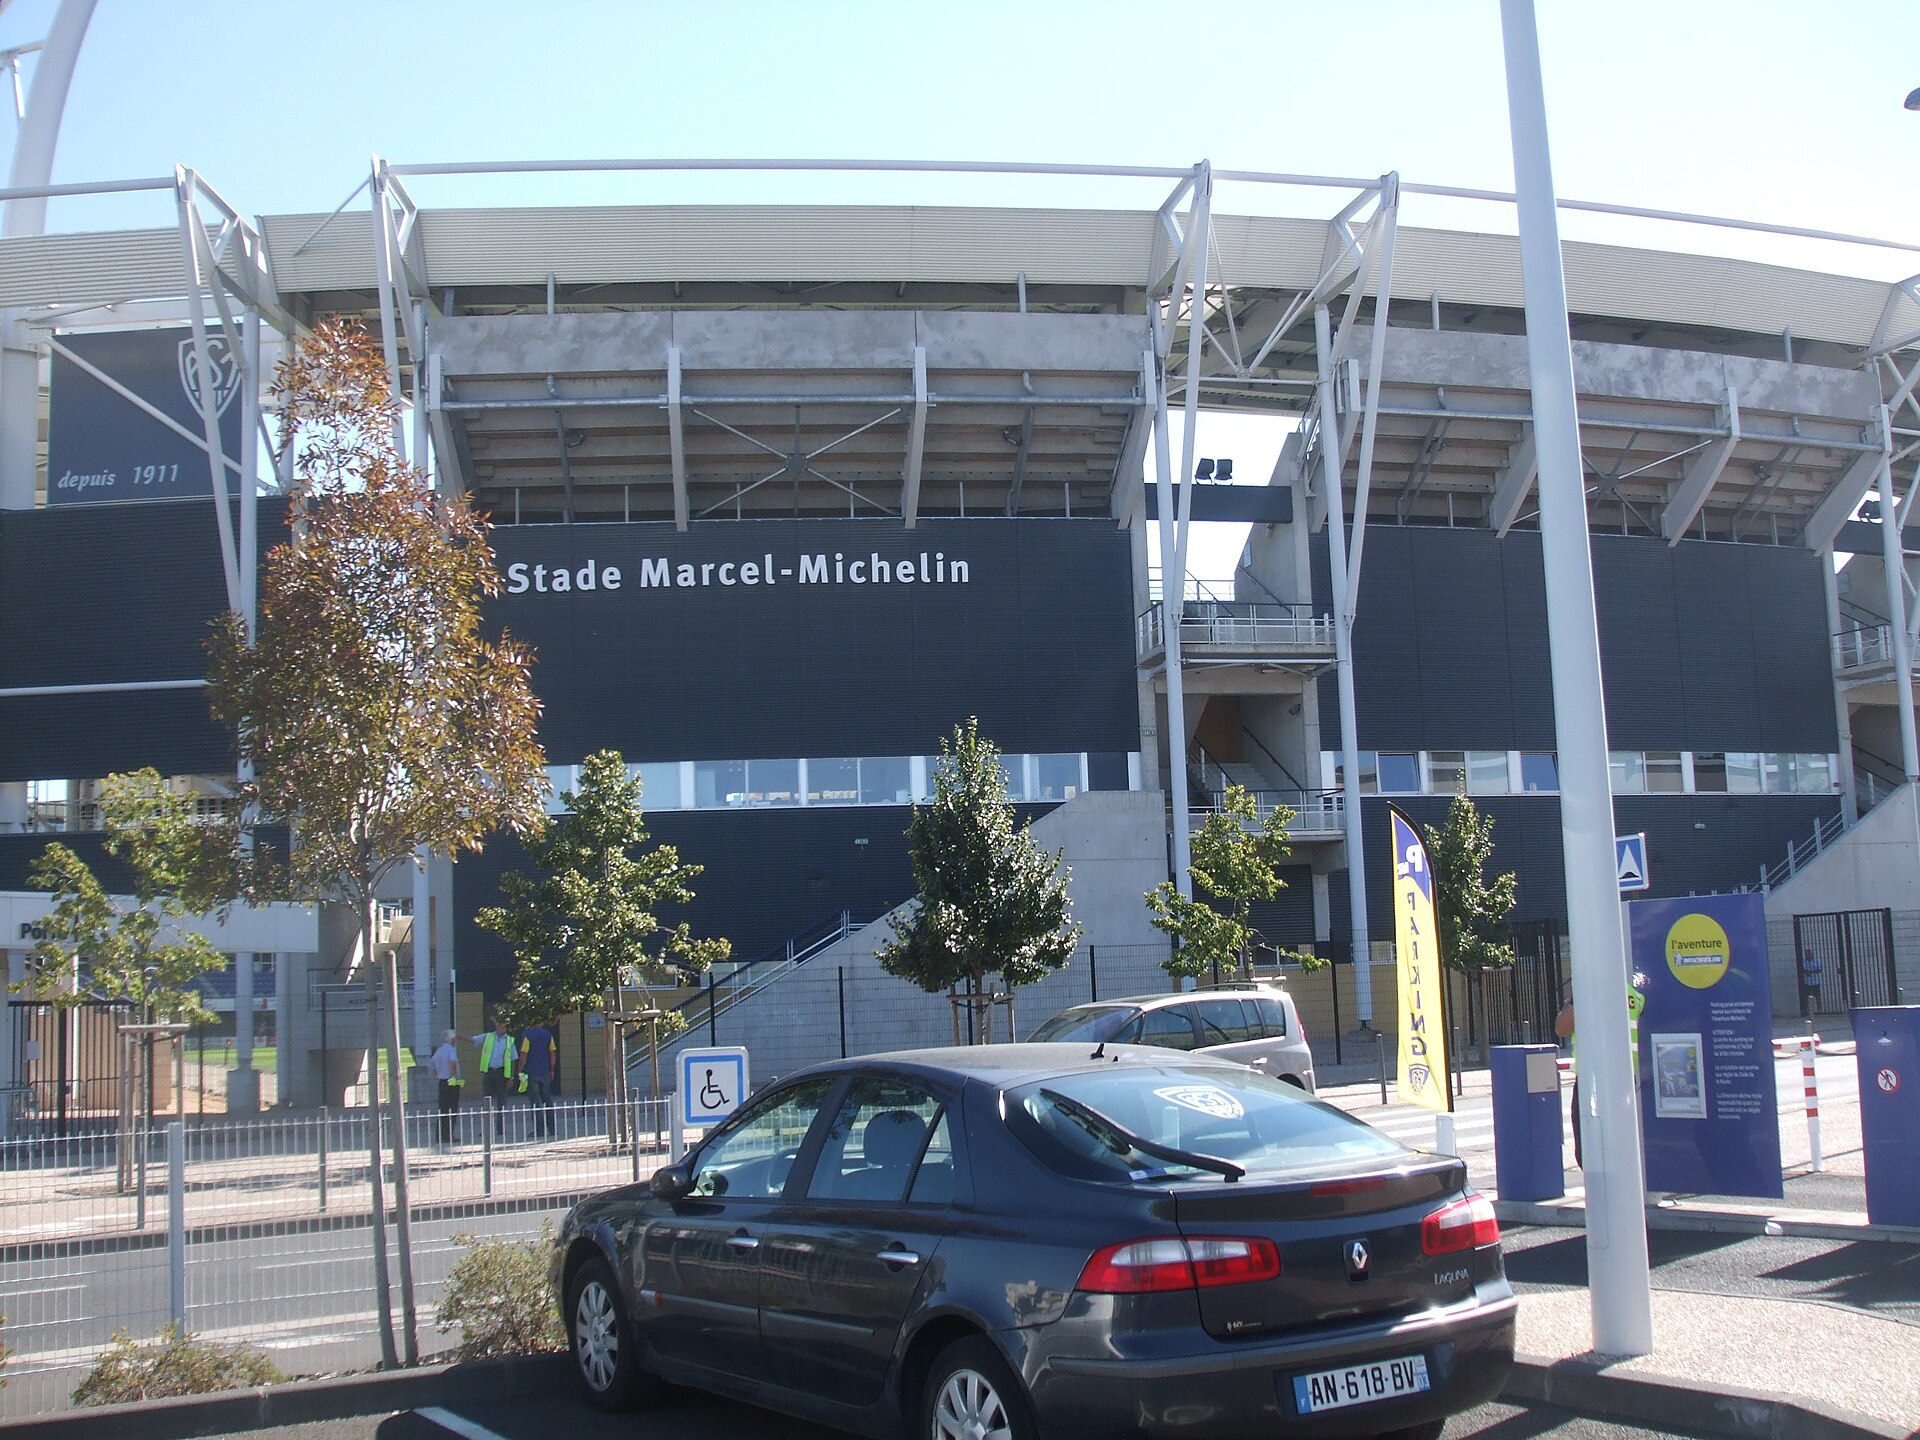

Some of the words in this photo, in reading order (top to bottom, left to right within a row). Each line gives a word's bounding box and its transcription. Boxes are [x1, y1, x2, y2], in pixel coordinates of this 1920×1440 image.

[57, 469, 116, 492] depuis
[133, 464, 178, 485] 1911
[507, 559, 622, 594] Stade
[640, 552, 970, 588] Marcel-Michelin
[1671, 939, 1722, 950] l'aventure
[1434, 1269, 1469, 1285] LAGUNA
